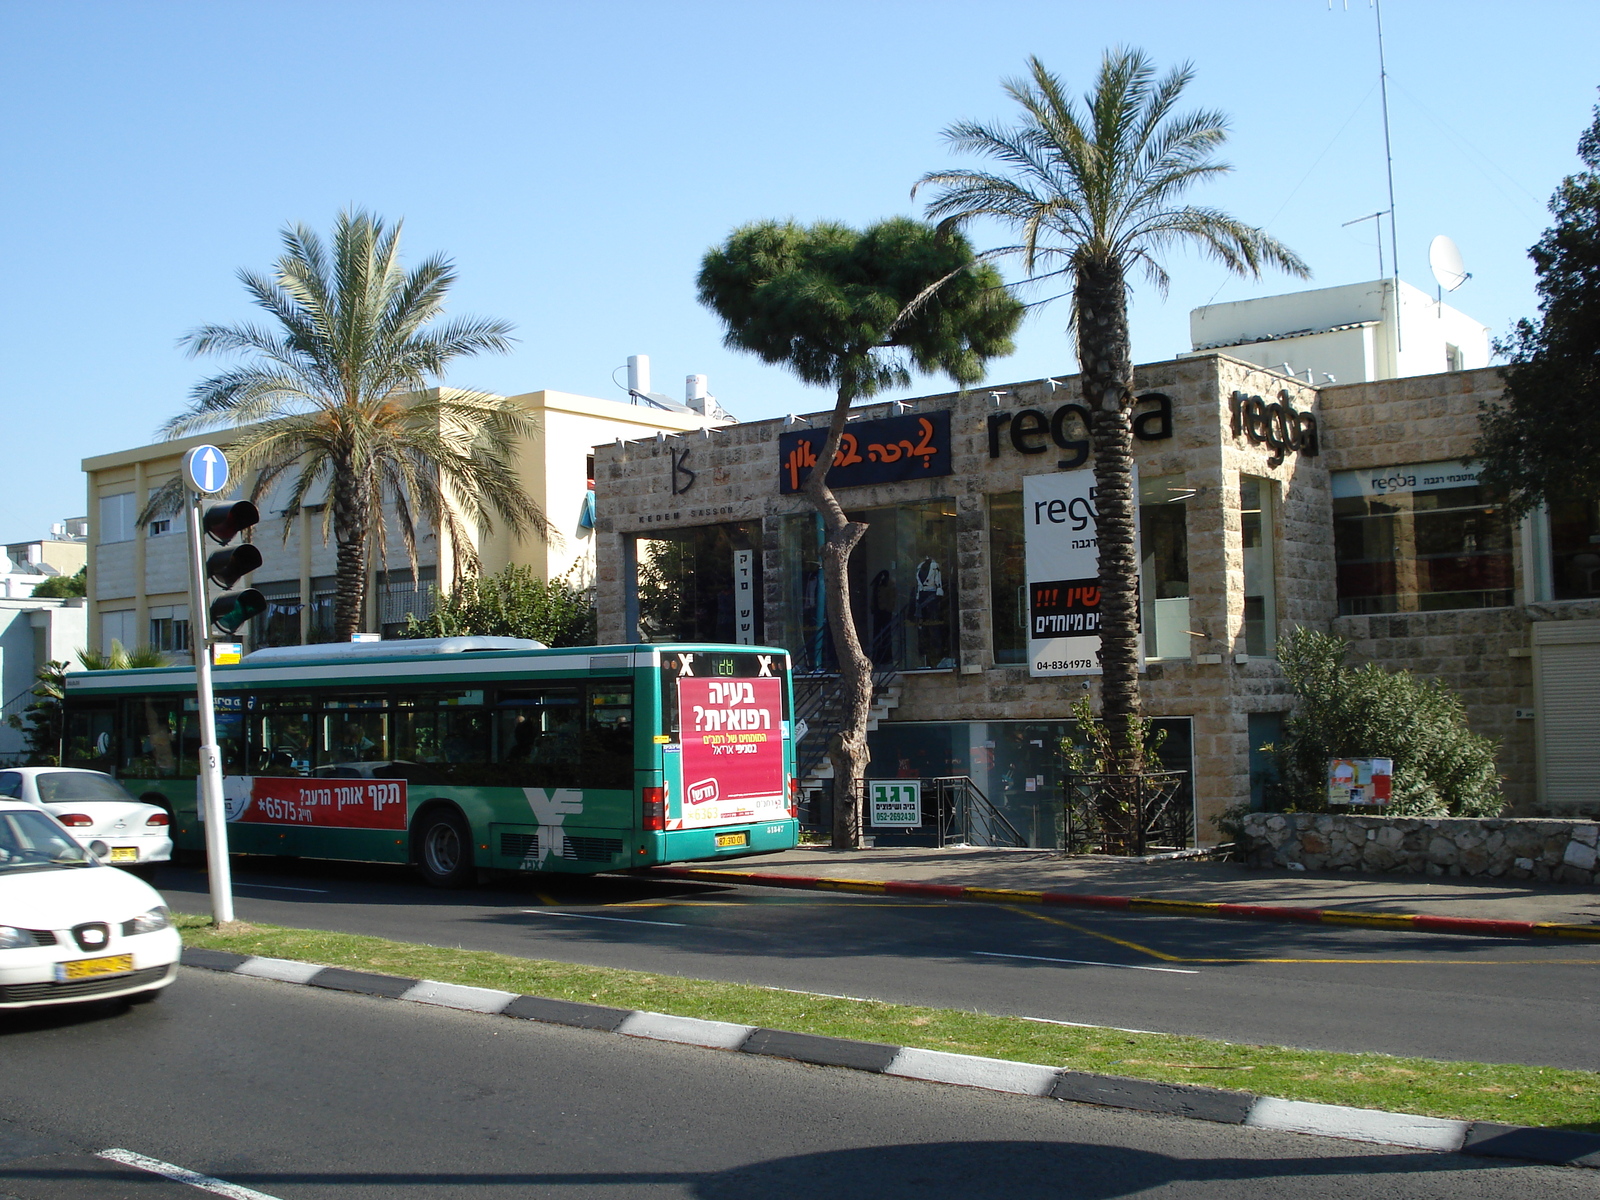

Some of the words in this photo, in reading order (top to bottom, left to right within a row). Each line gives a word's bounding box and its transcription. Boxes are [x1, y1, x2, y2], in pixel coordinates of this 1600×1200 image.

[987, 393, 1173, 468] rega
[1231, 389, 1319, 466] regba
[1371, 473, 1417, 492] regba
[1423, 476, 1445, 485] רגבה
[639, 512, 680, 524] KEDEM
[690, 506, 734, 518] SASSON
[1035, 486, 1100, 531] reg
[1036, 613, 1084, 633] מיוחדים
[1036, 659, 1092, 671] 04-8361978
[709, 682, 755, 707] בעיה
[692, 706, 771, 732] רפואית?
[726, 732, 738, 744] של
[711, 744, 734, 755] אריאל
[208, 756, 216, 768] 3
[299, 788, 331, 806] הרעב?
[334, 785, 364, 811] אותך
[368, 783, 400, 811] תקף
[875, 786, 915, 802] רגב
[298, 807, 313, 823] חייג
[876, 812, 916, 821] 052-2692430
